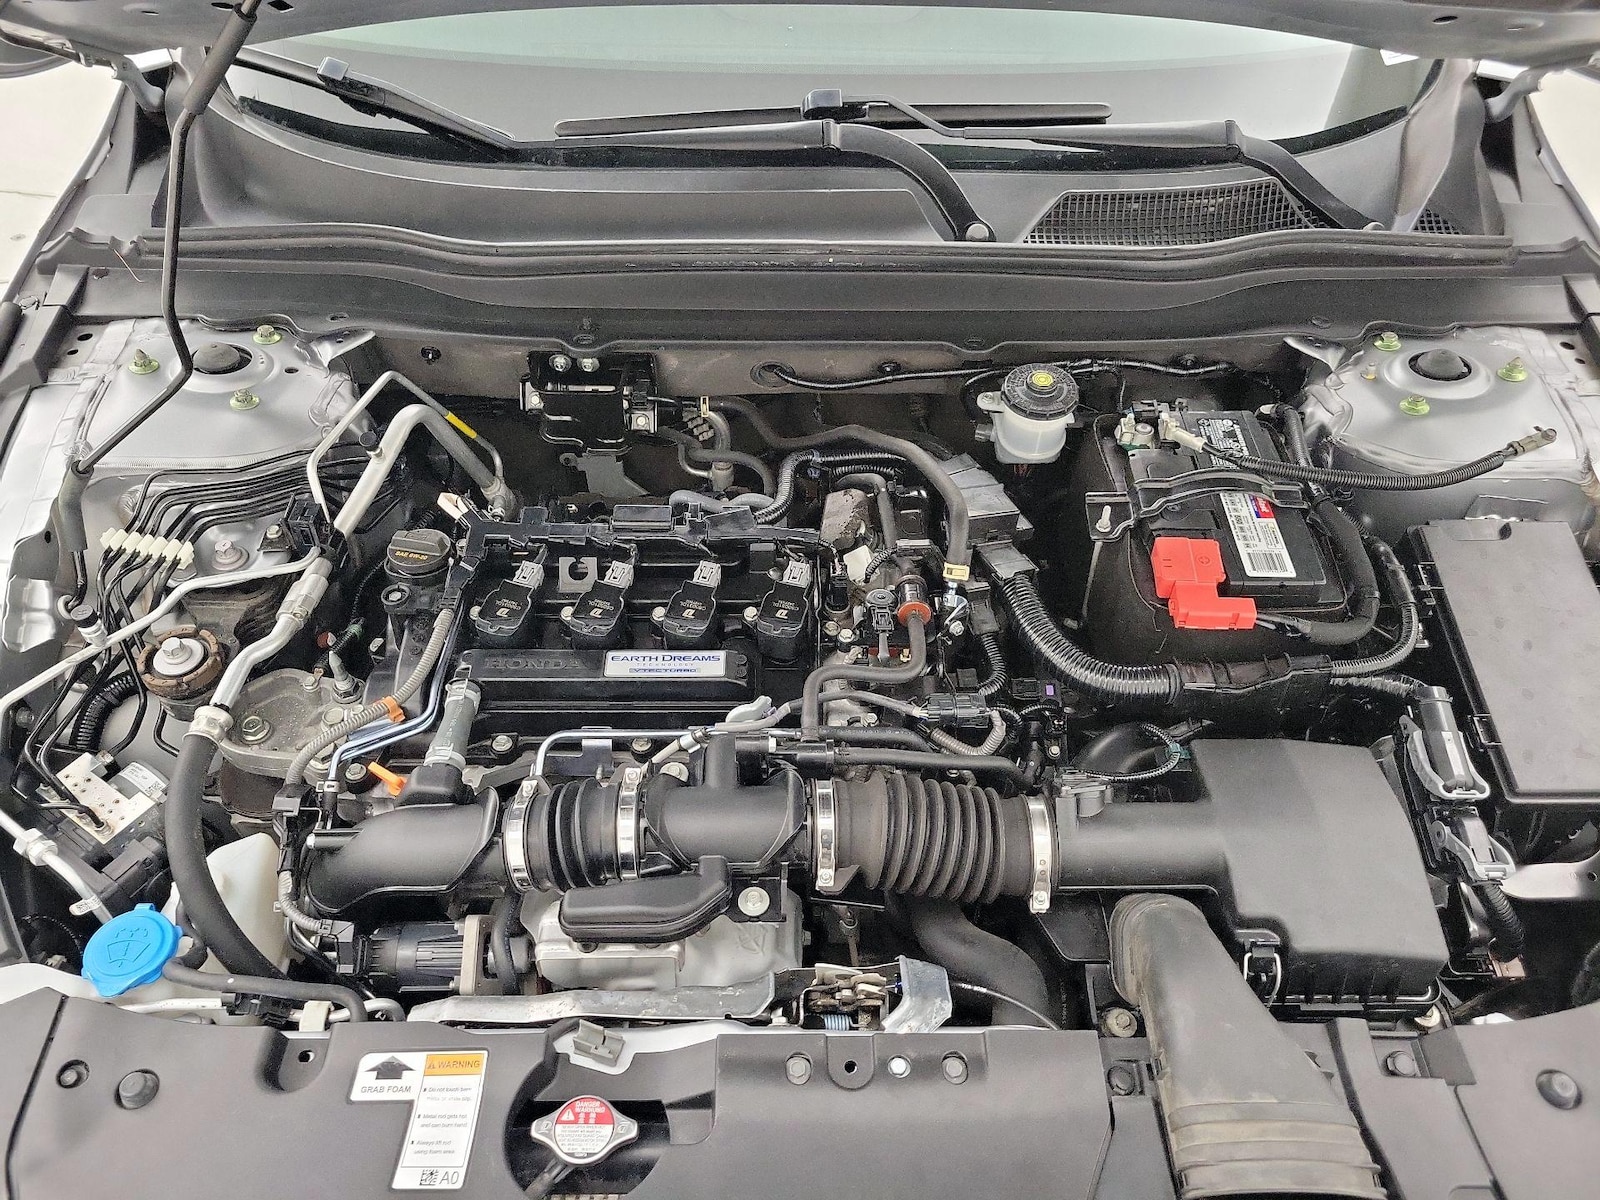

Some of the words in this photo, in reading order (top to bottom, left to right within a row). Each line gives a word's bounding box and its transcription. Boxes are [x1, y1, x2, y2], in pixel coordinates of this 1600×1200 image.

[662, 654, 721, 662] DREAMS
[485, 657, 581, 669] HONDA
[438, 1060, 481, 1069] WARNING
[360, 1085, 385, 1093] GRAB
[387, 1085, 412, 1093] FOAM
[439, 1171, 460, 1185] A0
